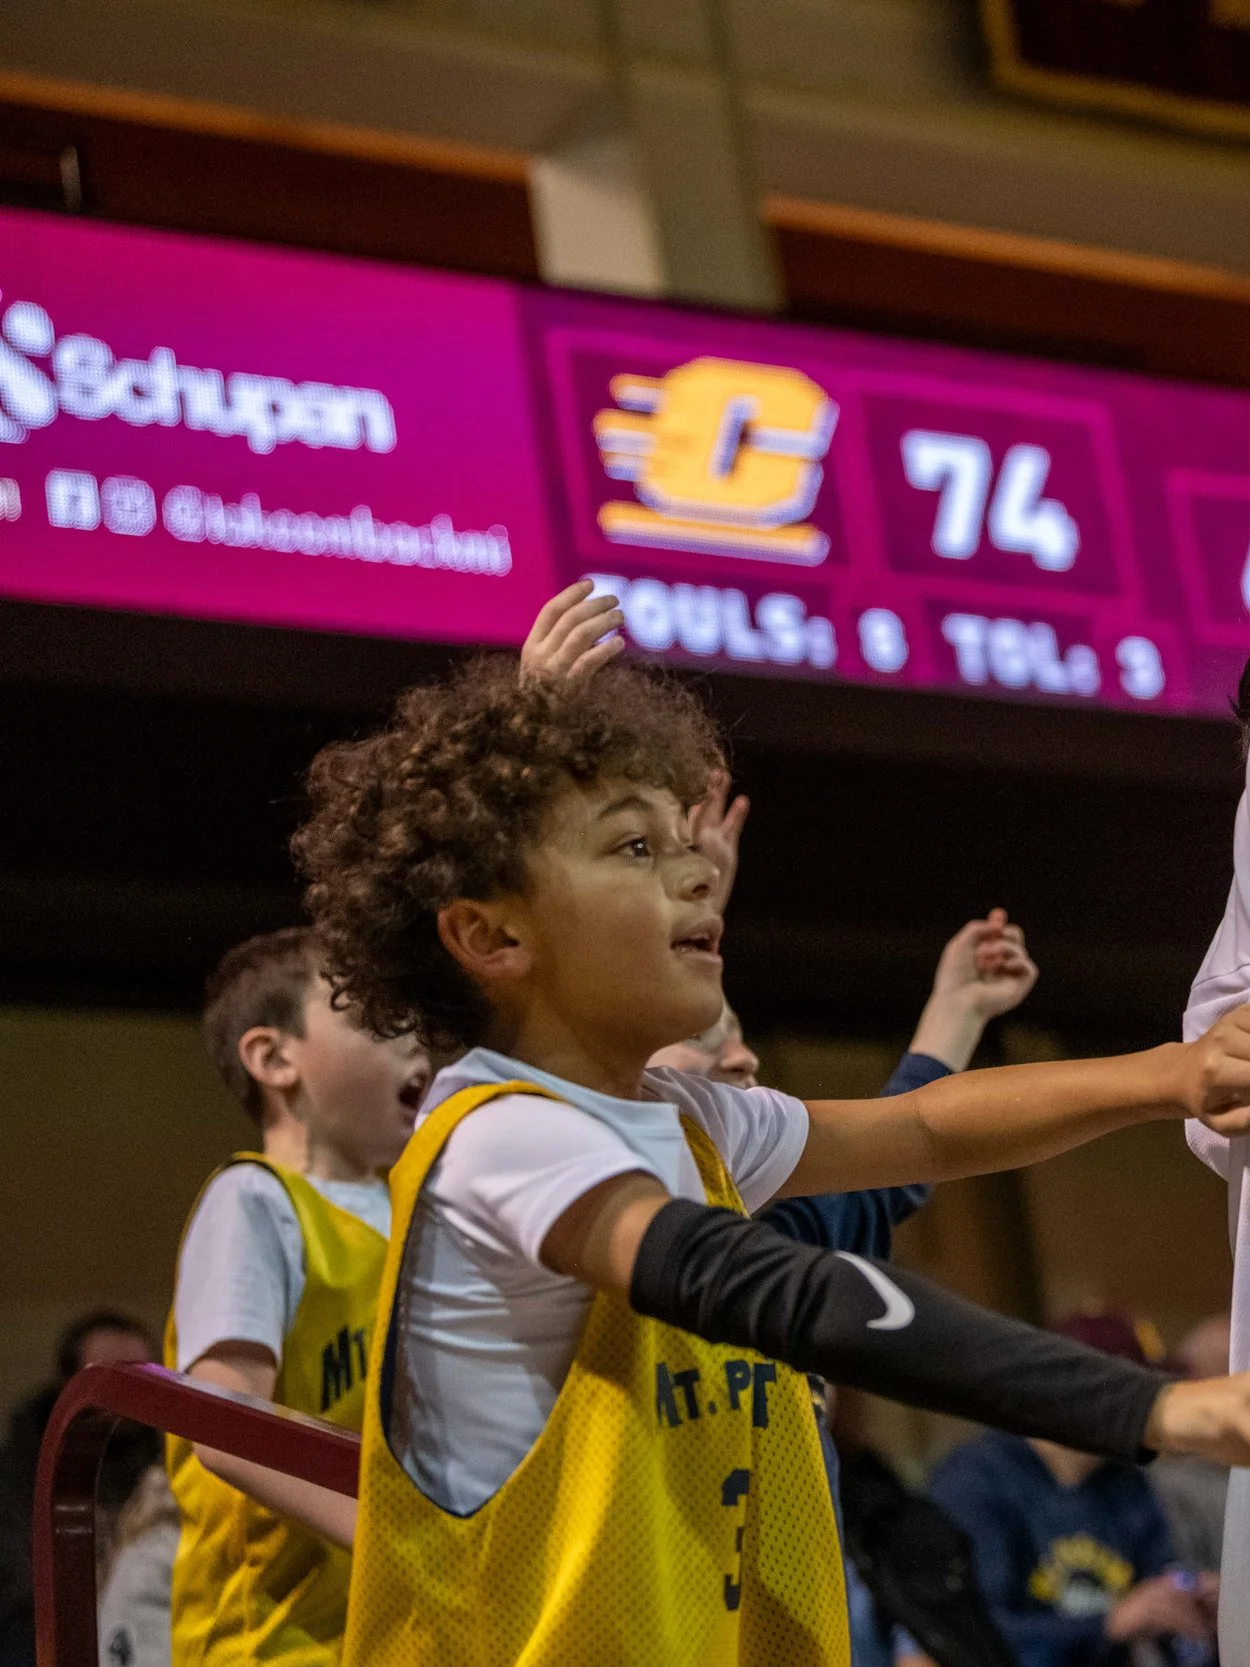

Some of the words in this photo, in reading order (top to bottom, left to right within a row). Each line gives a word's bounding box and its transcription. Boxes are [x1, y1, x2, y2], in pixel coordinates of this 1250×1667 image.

[52, 332, 397, 454] Schupan
[901, 428, 1079, 572] 74
[1115, 636, 1165, 700] 3
